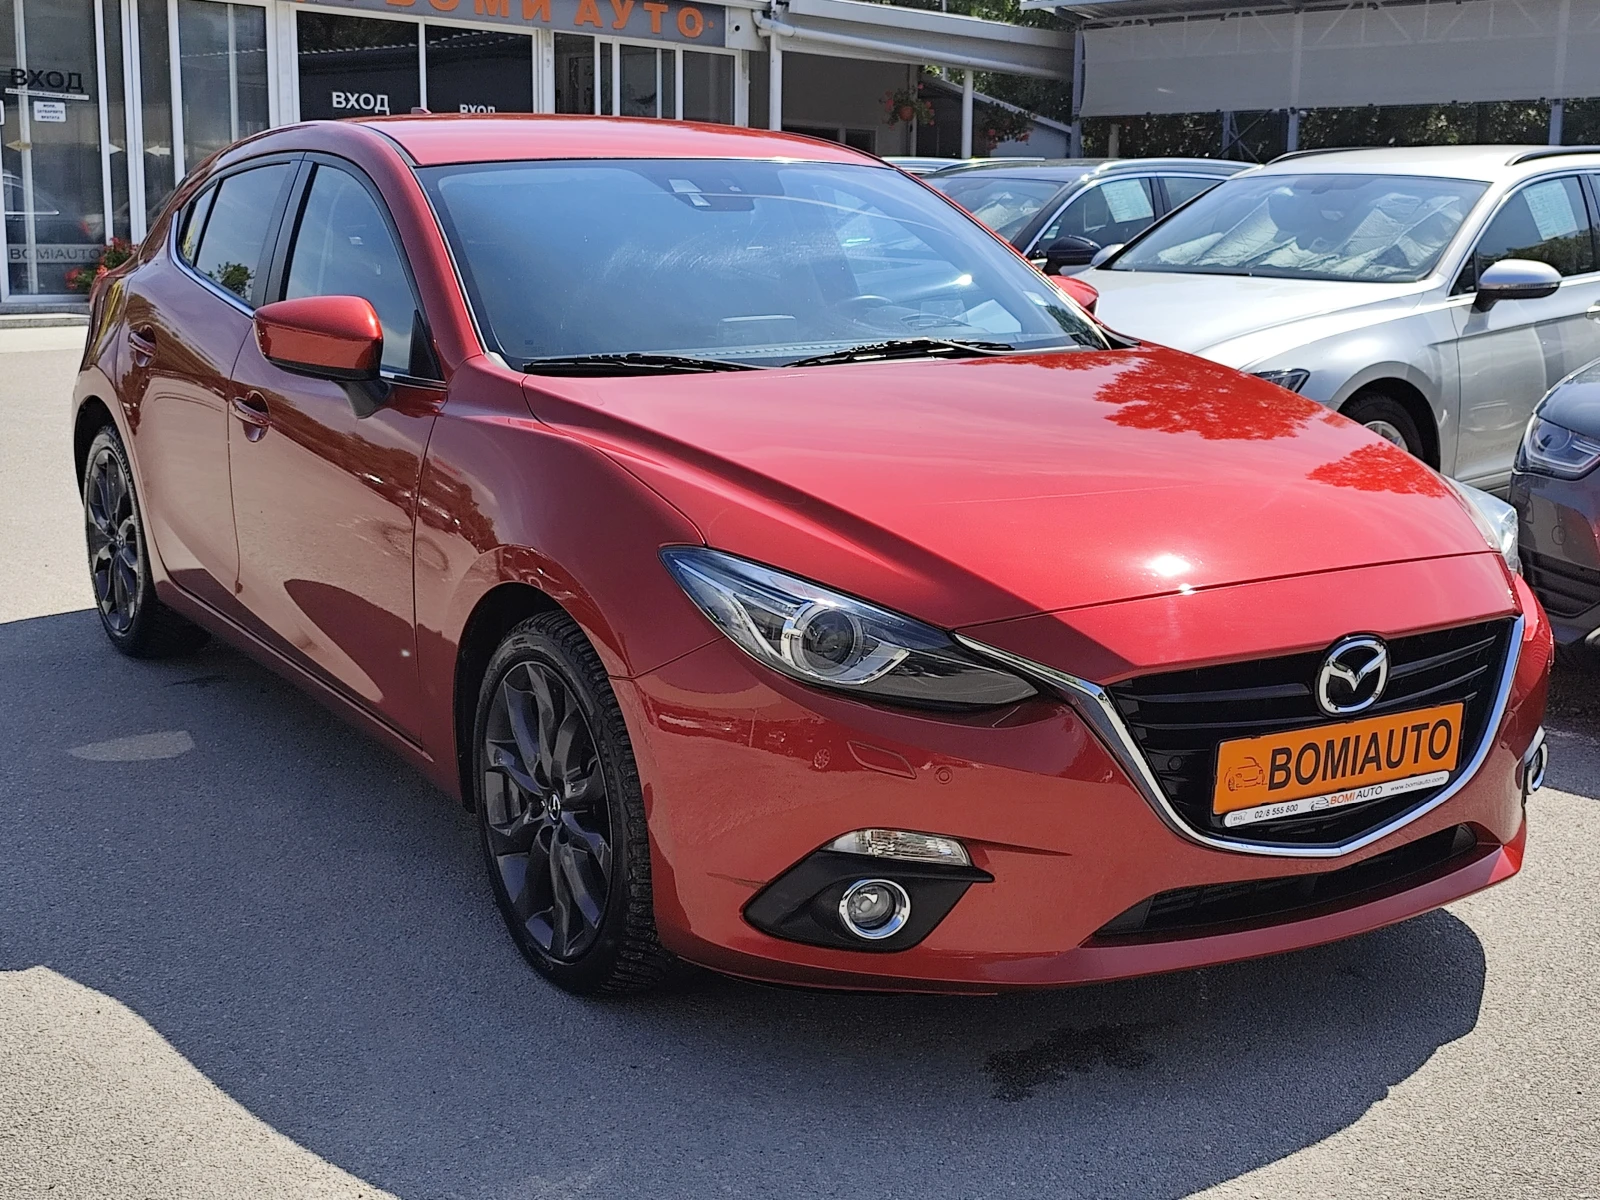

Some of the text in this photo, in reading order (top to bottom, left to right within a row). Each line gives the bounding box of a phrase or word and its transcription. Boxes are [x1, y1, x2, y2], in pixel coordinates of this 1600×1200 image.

[386, 0, 704, 38] МИ АУТО
[11, 68, 84, 94] ВХОД
[332, 91, 390, 116] ВХОД
[1267, 718, 1452, 791] BOMIAUTO
[1272, 806, 1285, 816] 555
[1285, 803, 1299, 813] 800
[1330, 792, 1356, 805] BOMI
[1356, 785, 1383, 799] AUTO
[1390, 776, 1445, 792] www.bomiauto.com
